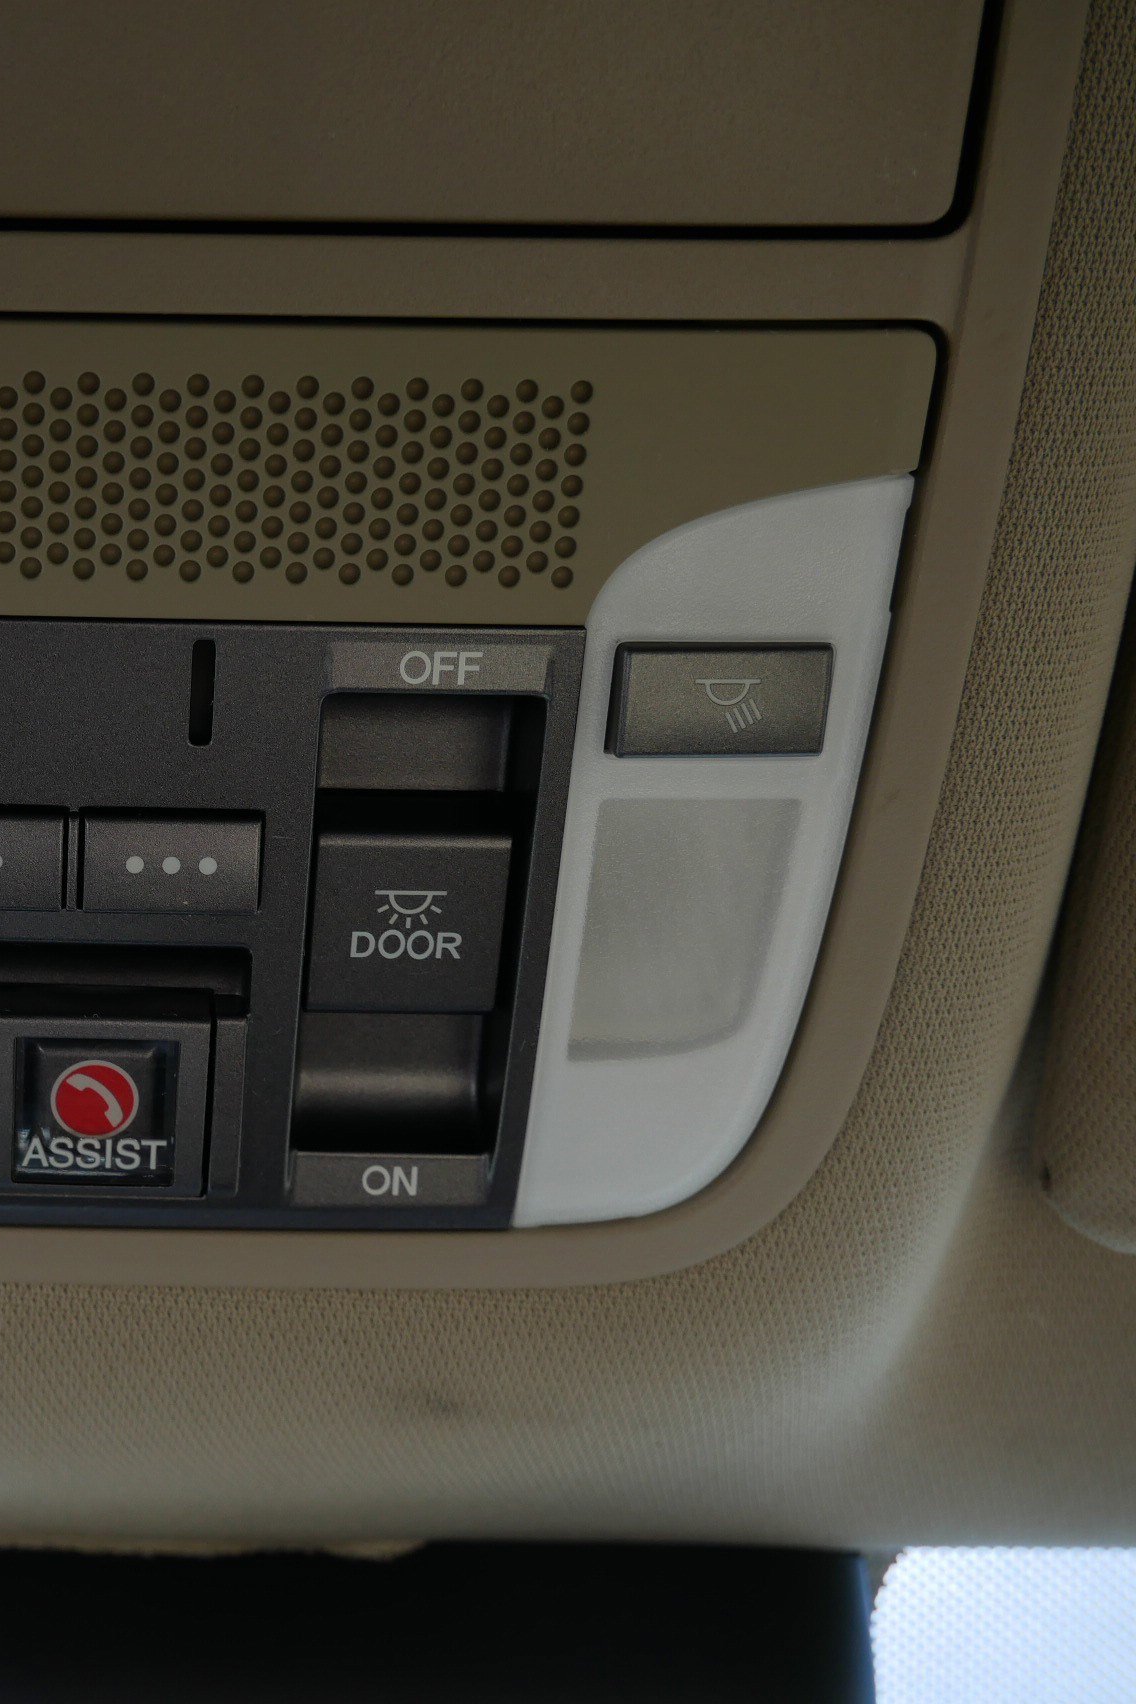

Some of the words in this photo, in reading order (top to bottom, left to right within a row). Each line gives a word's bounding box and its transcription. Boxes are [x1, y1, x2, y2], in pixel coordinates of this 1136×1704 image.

[399, 650, 483, 686] OFF
[349, 929, 462, 960] DOOR
[21, 1136, 167, 1170] ASSIST
[361, 1165, 418, 1196] ON
